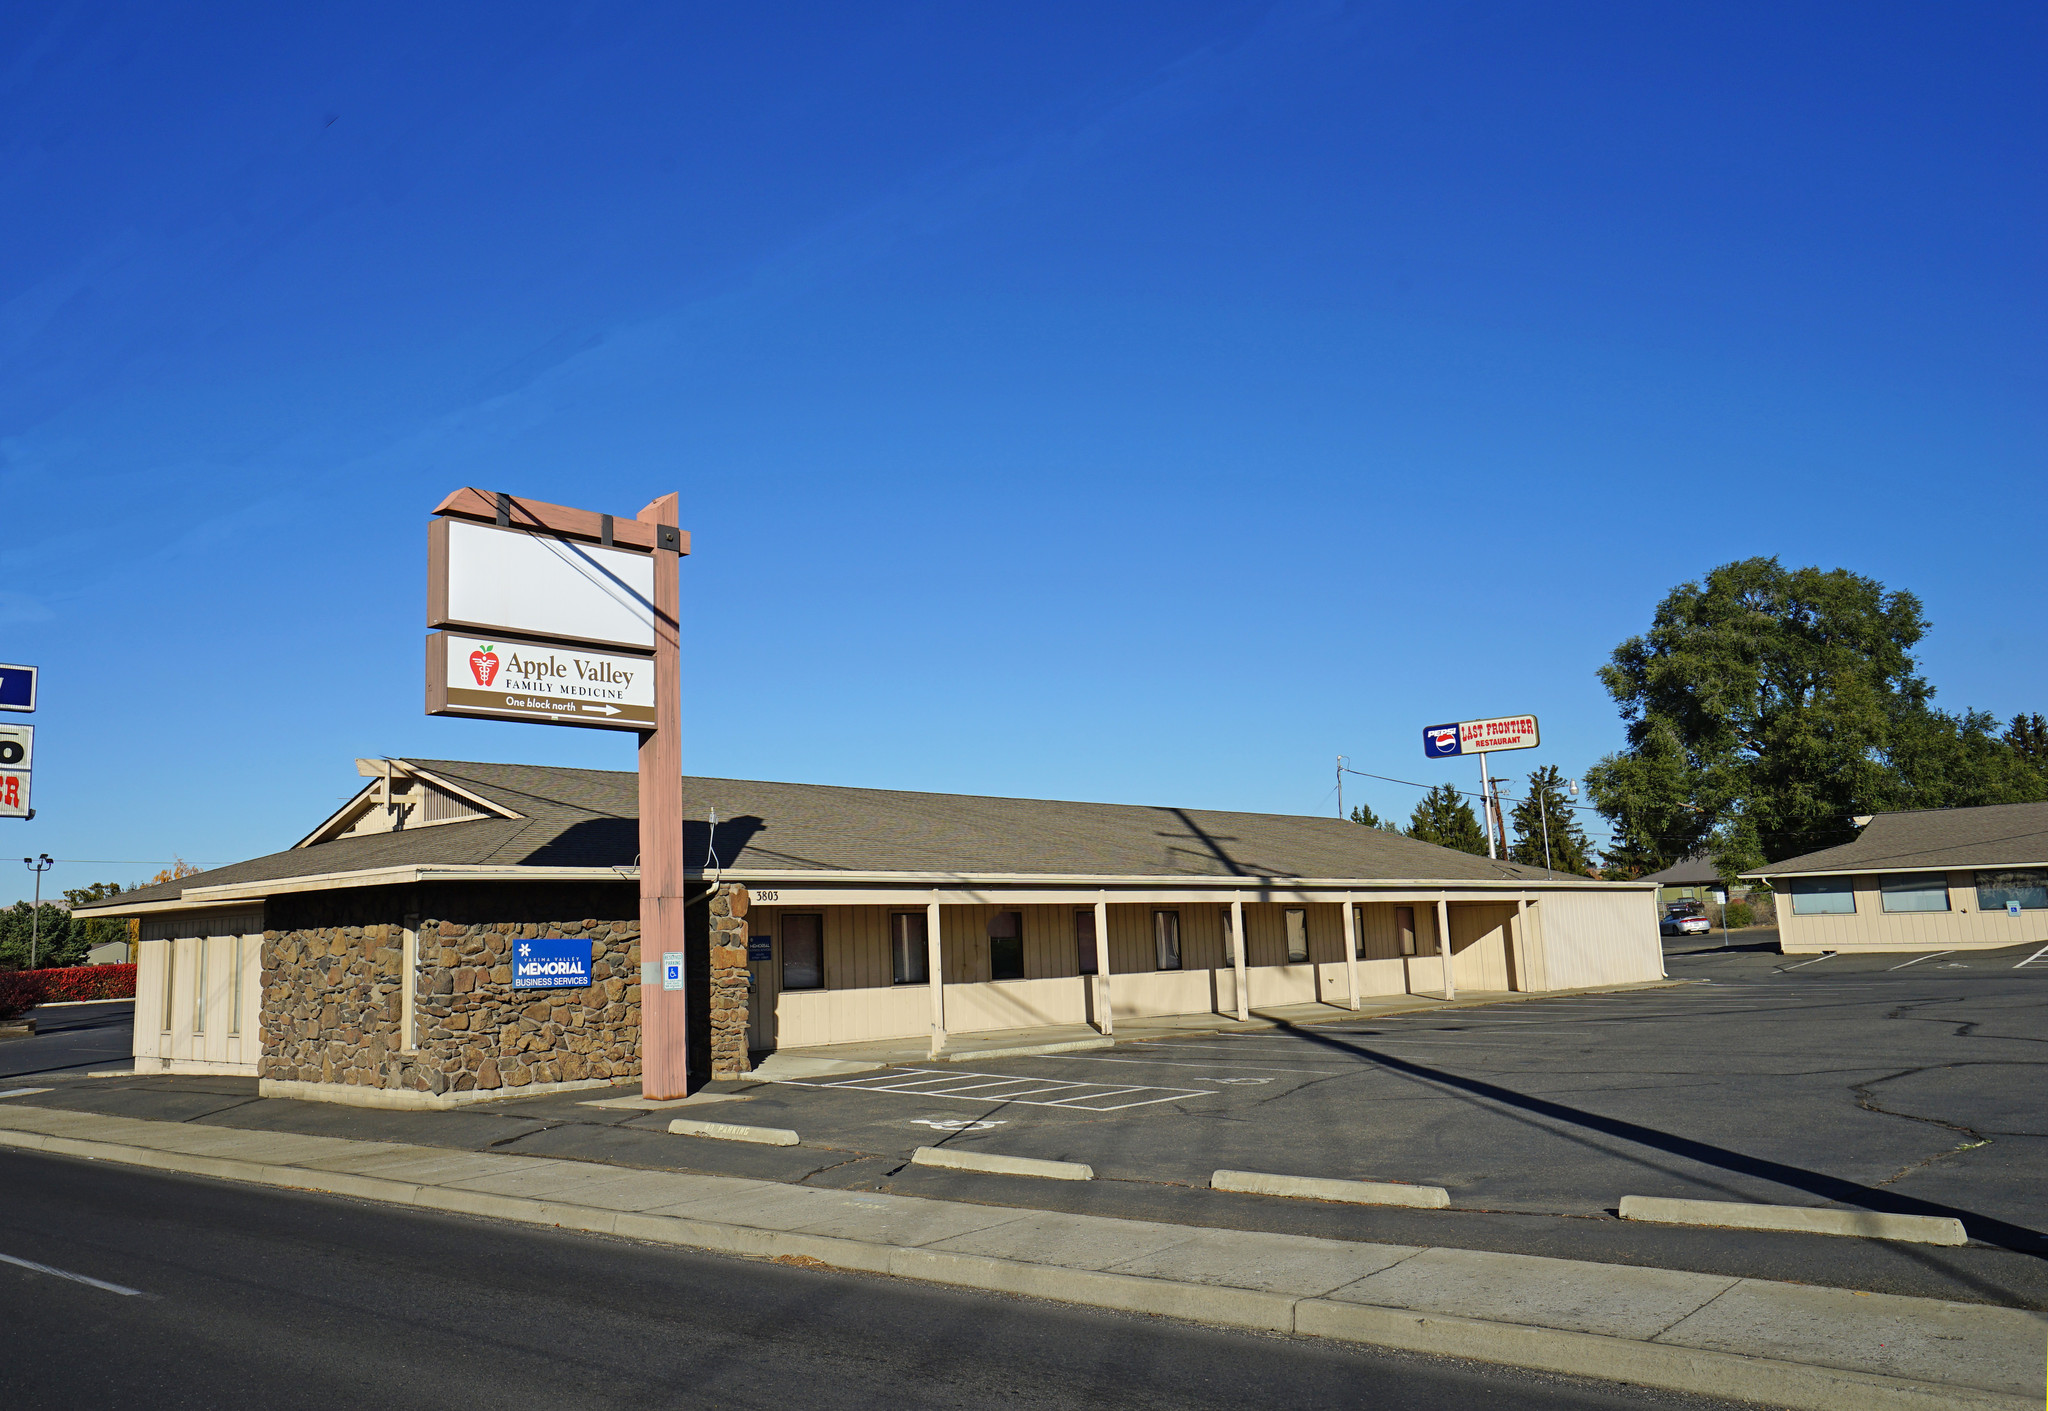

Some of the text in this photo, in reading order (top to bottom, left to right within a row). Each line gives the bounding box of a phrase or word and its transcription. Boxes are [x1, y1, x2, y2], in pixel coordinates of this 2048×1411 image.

[505, 652, 634, 690] Apple Valley
[506, 679, 623, 700] FAMILY MEDICINE
[505, 696, 576, 712] One block north
[1427, 727, 1457, 738] PEPSI
[1461, 719, 1534, 742] LAST FRONTIER
[1475, 736, 1521, 748] RESTAURANT
[756, 891, 779, 902] 3803
[518, 961, 585, 976] MEMORIAL
[515, 976, 588, 987] BUSINESS SERVICES
[718, 1125, 751, 1136] PARKING
